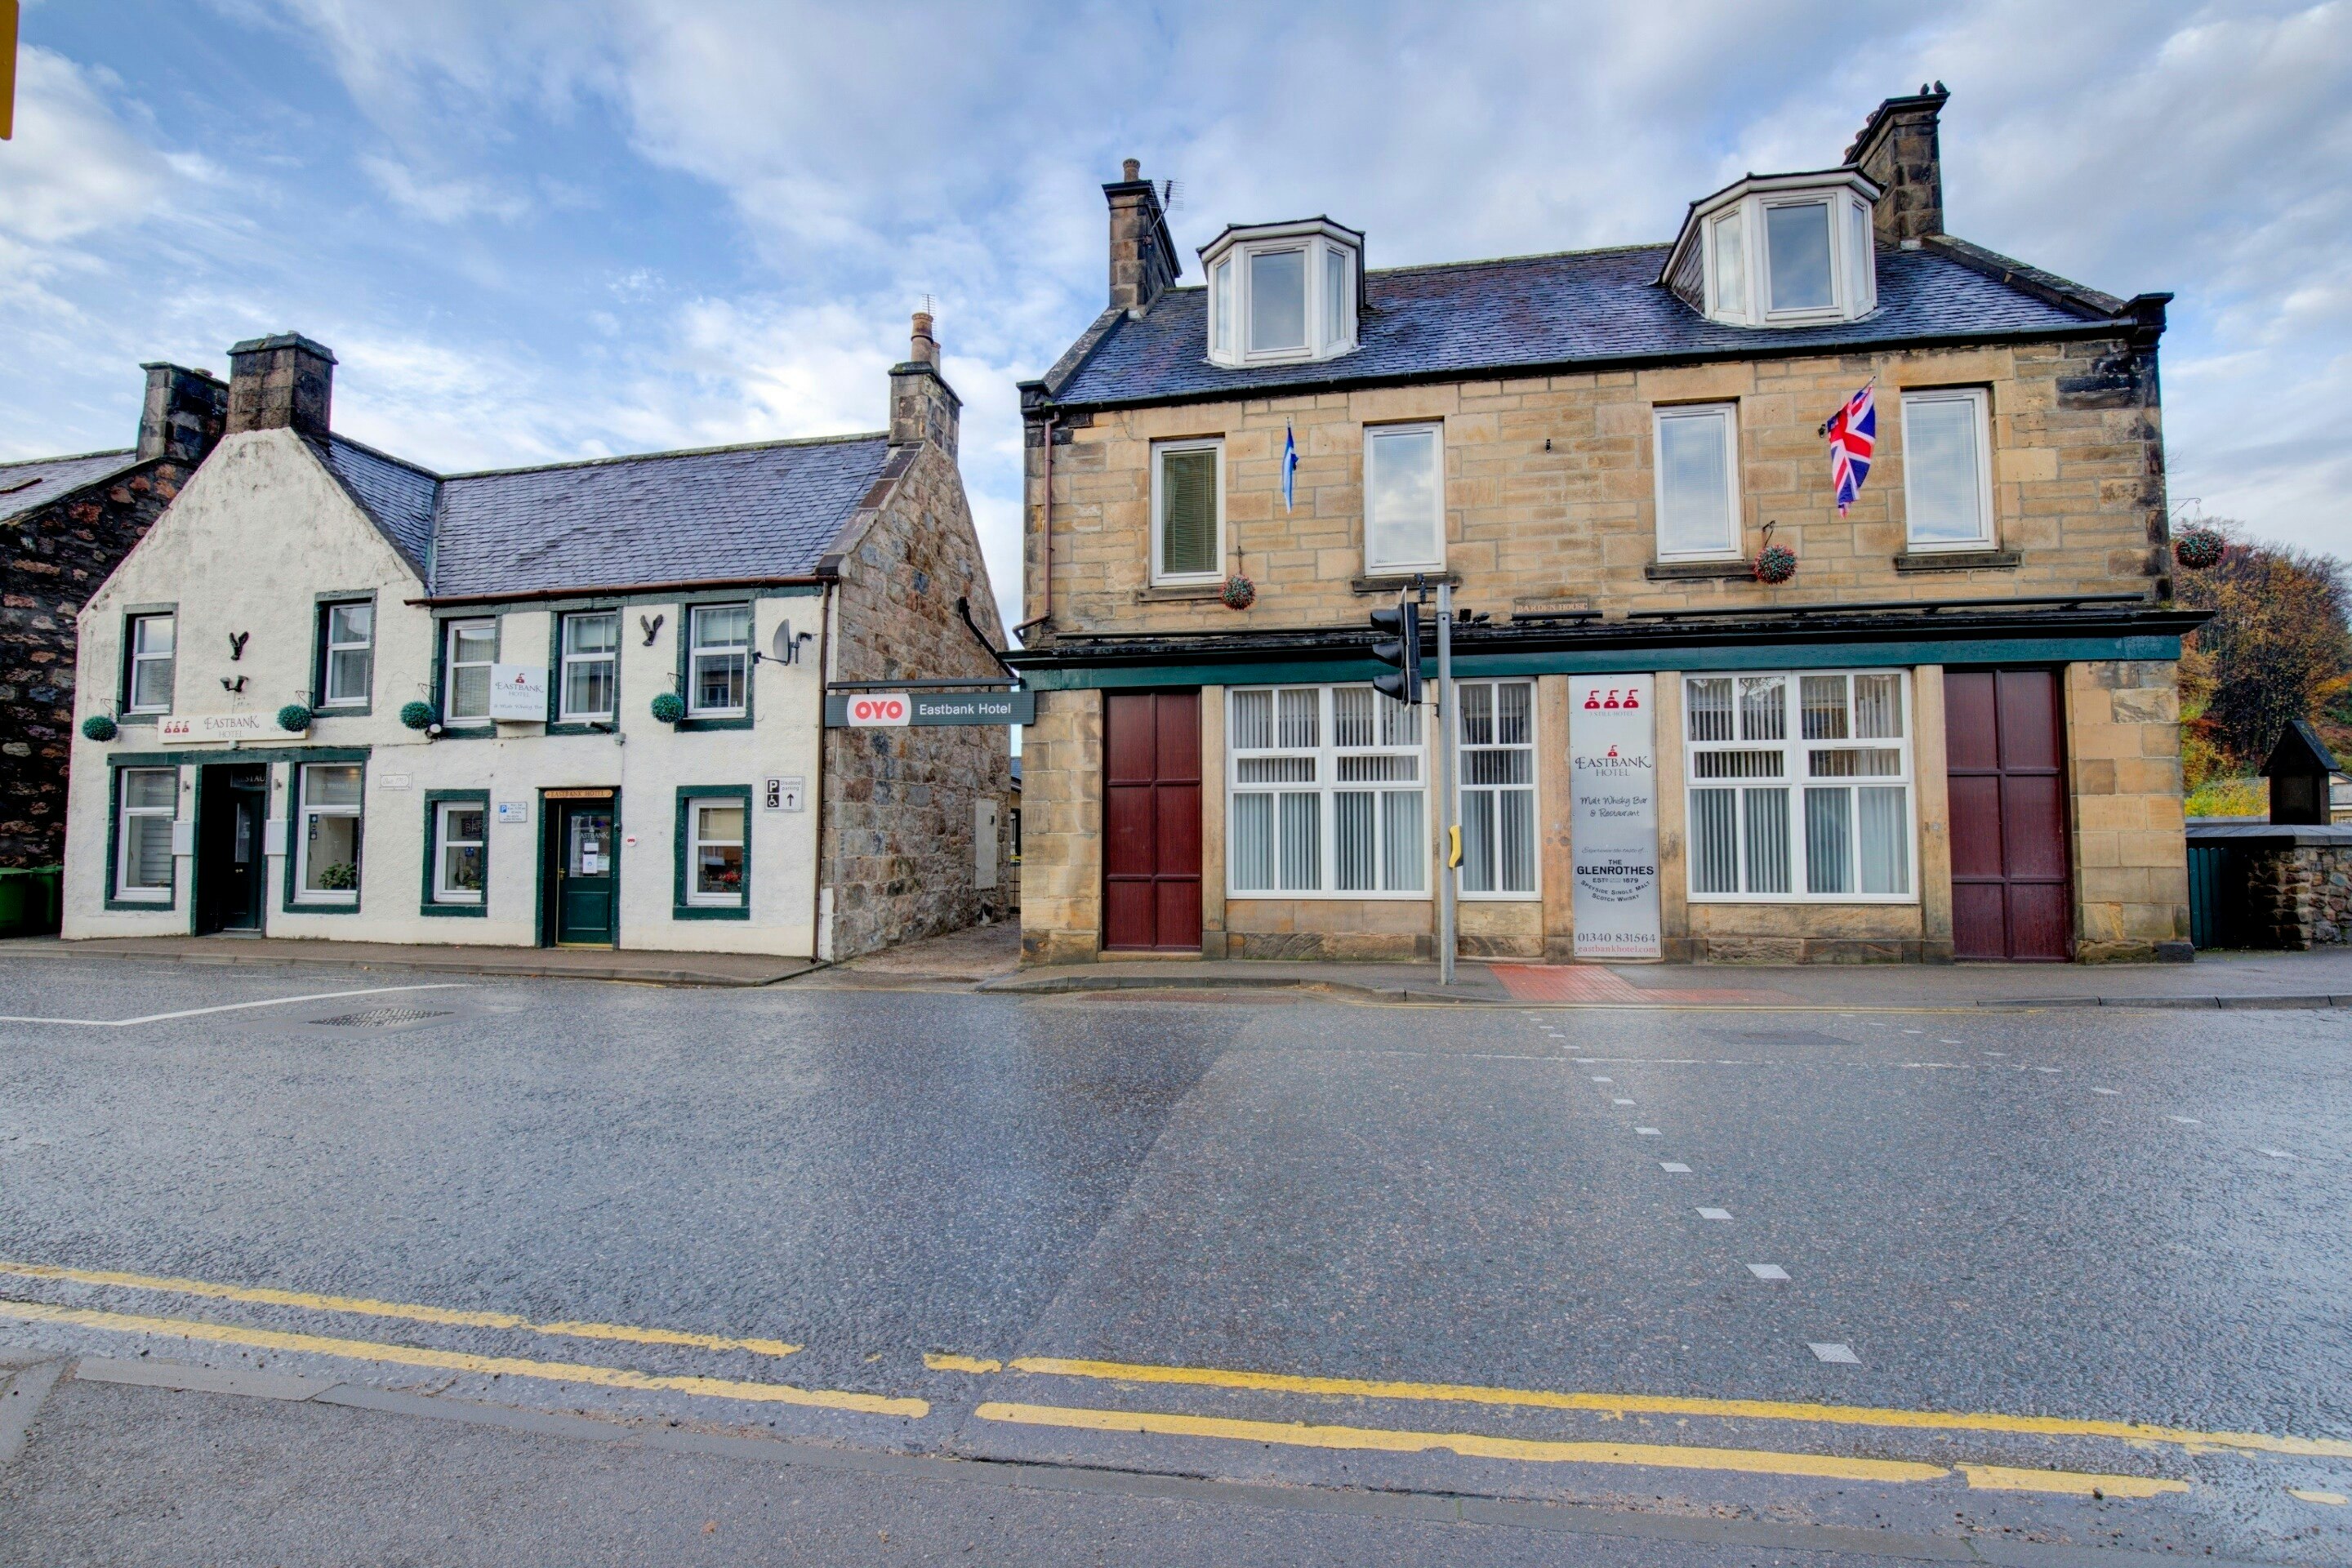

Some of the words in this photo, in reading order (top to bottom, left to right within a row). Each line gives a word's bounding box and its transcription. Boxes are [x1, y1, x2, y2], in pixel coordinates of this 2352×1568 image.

[1517, 604, 1556, 612] BARDEN
[1559, 603, 1588, 611] HOUSE
[496, 682, 544, 693] EASTBANK
[855, 701, 903, 719] OYO
[920, 703, 974, 715] Eastbank
[978, 703, 1011, 715] Hotel
[204, 715, 260, 730] EASTBANK
[218, 730, 243, 739] HOTEL
[1575, 755, 1651, 769] EASTBANK
[1596, 768, 1630, 777] HOTEL
[1580, 796, 1601, 805] Malt
[1603, 795, 1631, 807] Whisky
[1633, 795, 1648, 804] Bar
[1598, 808, 1640, 817] Restaurant
[1577, 866, 1654, 875] GLENROTHES
[1580, 880, 1609, 895] SPEYSIDE
[1635, 881, 1650, 892] MALT
[1591, 893, 1615, 902] SCOTCH
[1578, 933, 1611, 942] 01340
[1615, 933, 1655, 943] 831564
[1578, 945, 1656, 954] eastbankhotel.com
